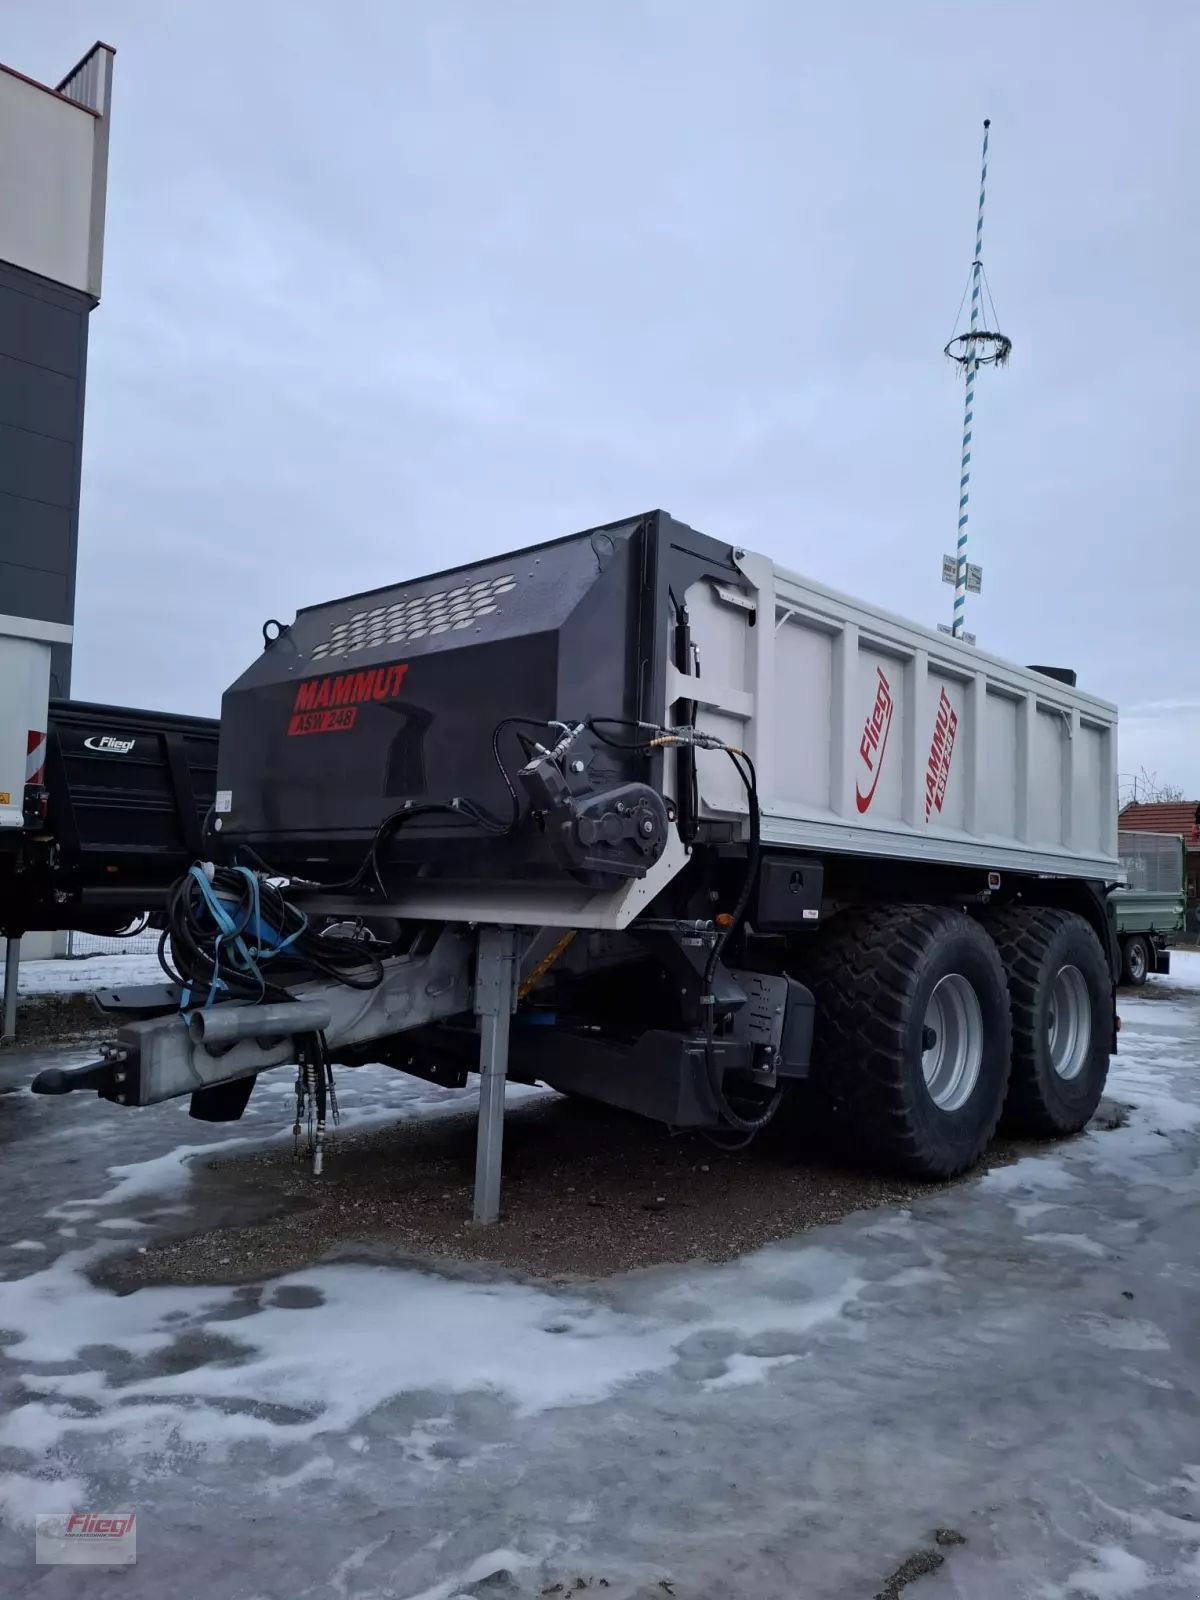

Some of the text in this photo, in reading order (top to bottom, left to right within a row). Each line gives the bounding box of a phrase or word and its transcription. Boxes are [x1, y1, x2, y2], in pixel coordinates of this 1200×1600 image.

[294, 664, 408, 711] MAMMUT
[296, 708, 353, 731] ASW 248
[860, 665, 890, 772] Fliegl
[100, 736, 135, 752] Fliegl
